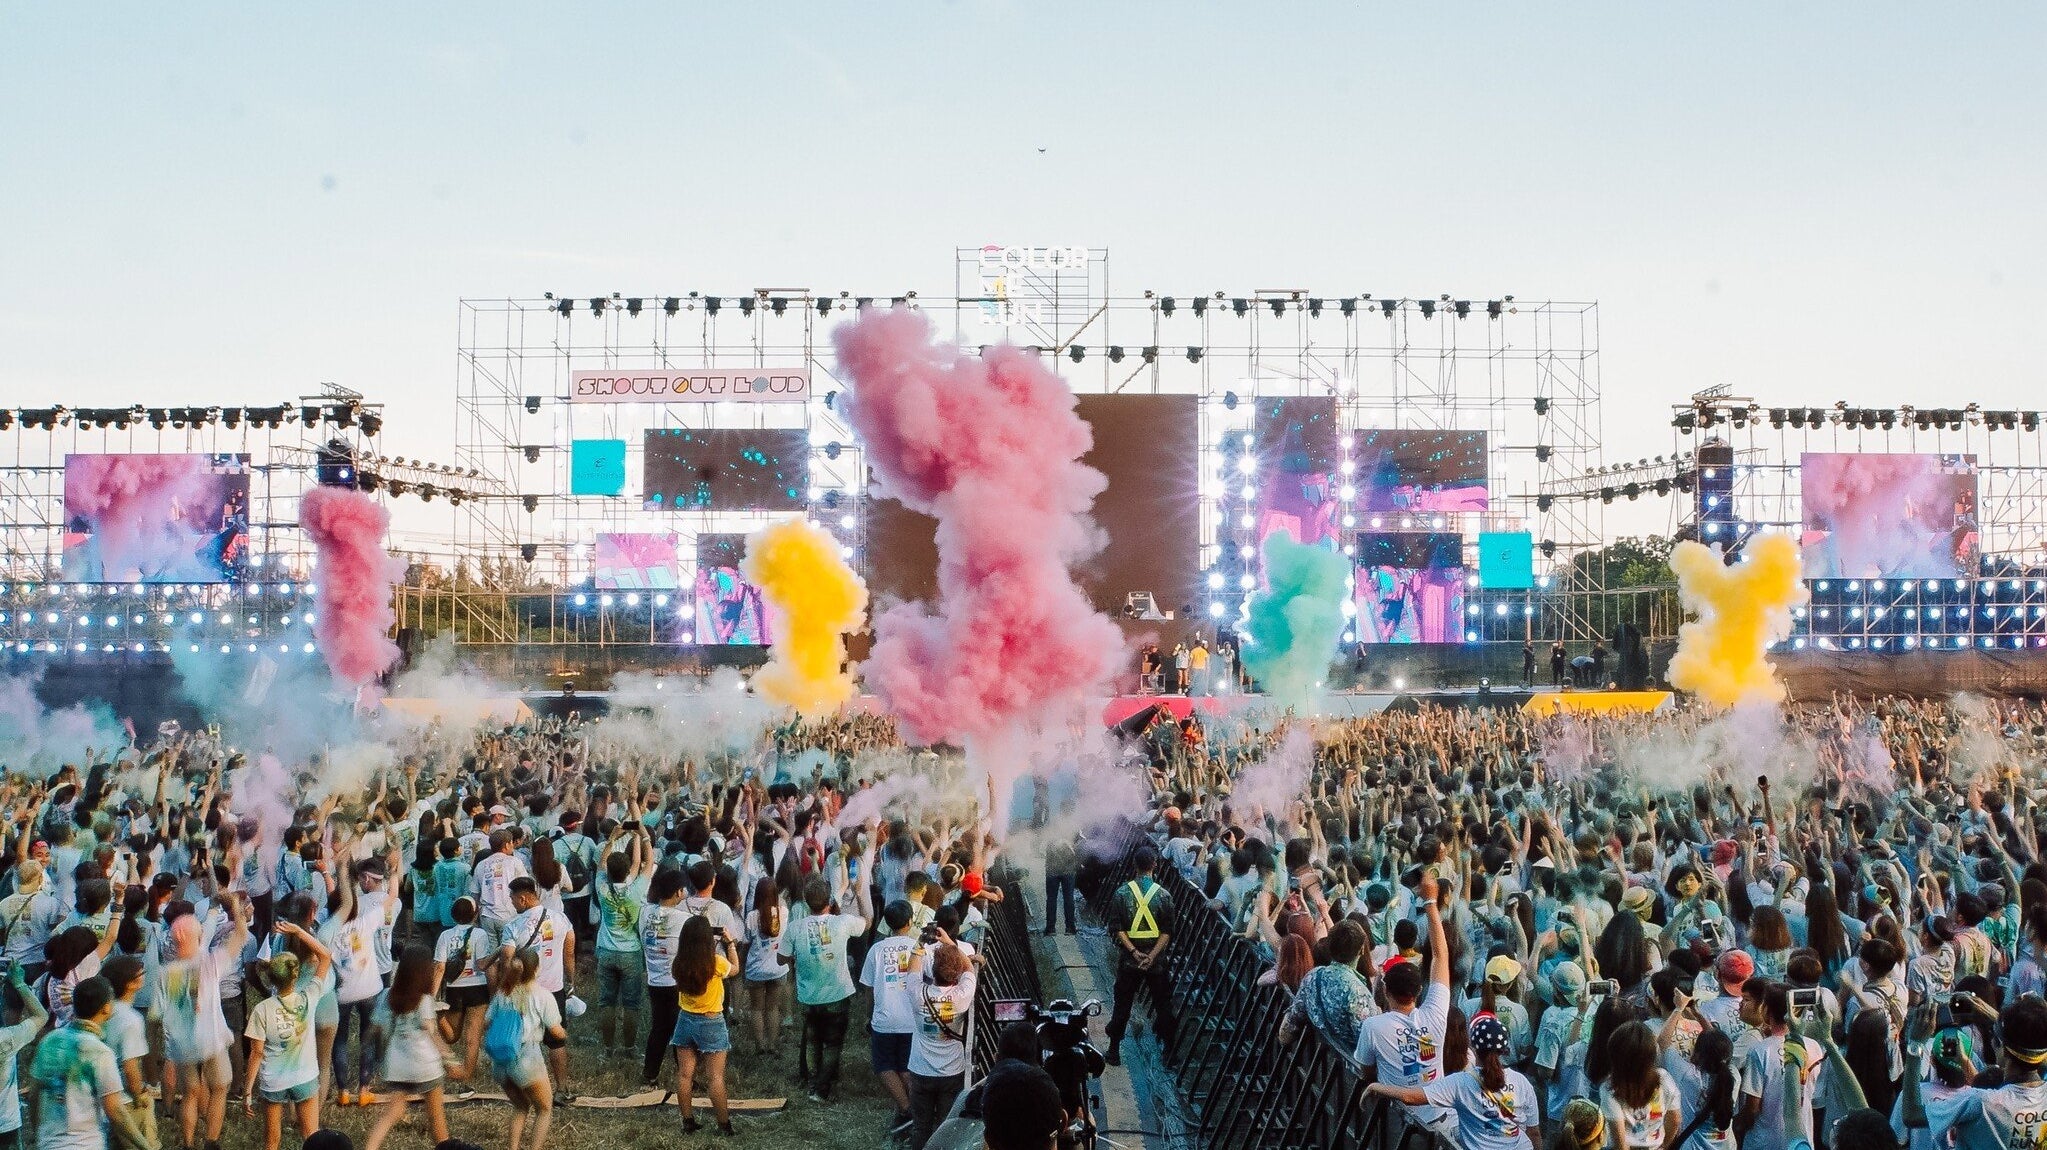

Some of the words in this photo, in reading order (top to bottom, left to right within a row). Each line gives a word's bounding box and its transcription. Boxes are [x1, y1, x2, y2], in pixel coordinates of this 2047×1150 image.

[978, 245, 1089, 269] COLOR
[979, 273, 1024, 298] ME
[578, 378, 668, 395] SHOUT
[672, 377, 726, 394] OUT
[733, 377, 805, 393] LOUD
[884, 945, 908, 953] COLOR
[1396, 1027, 1429, 1037] COLOR
[2015, 1109, 2047, 1124] COLO
